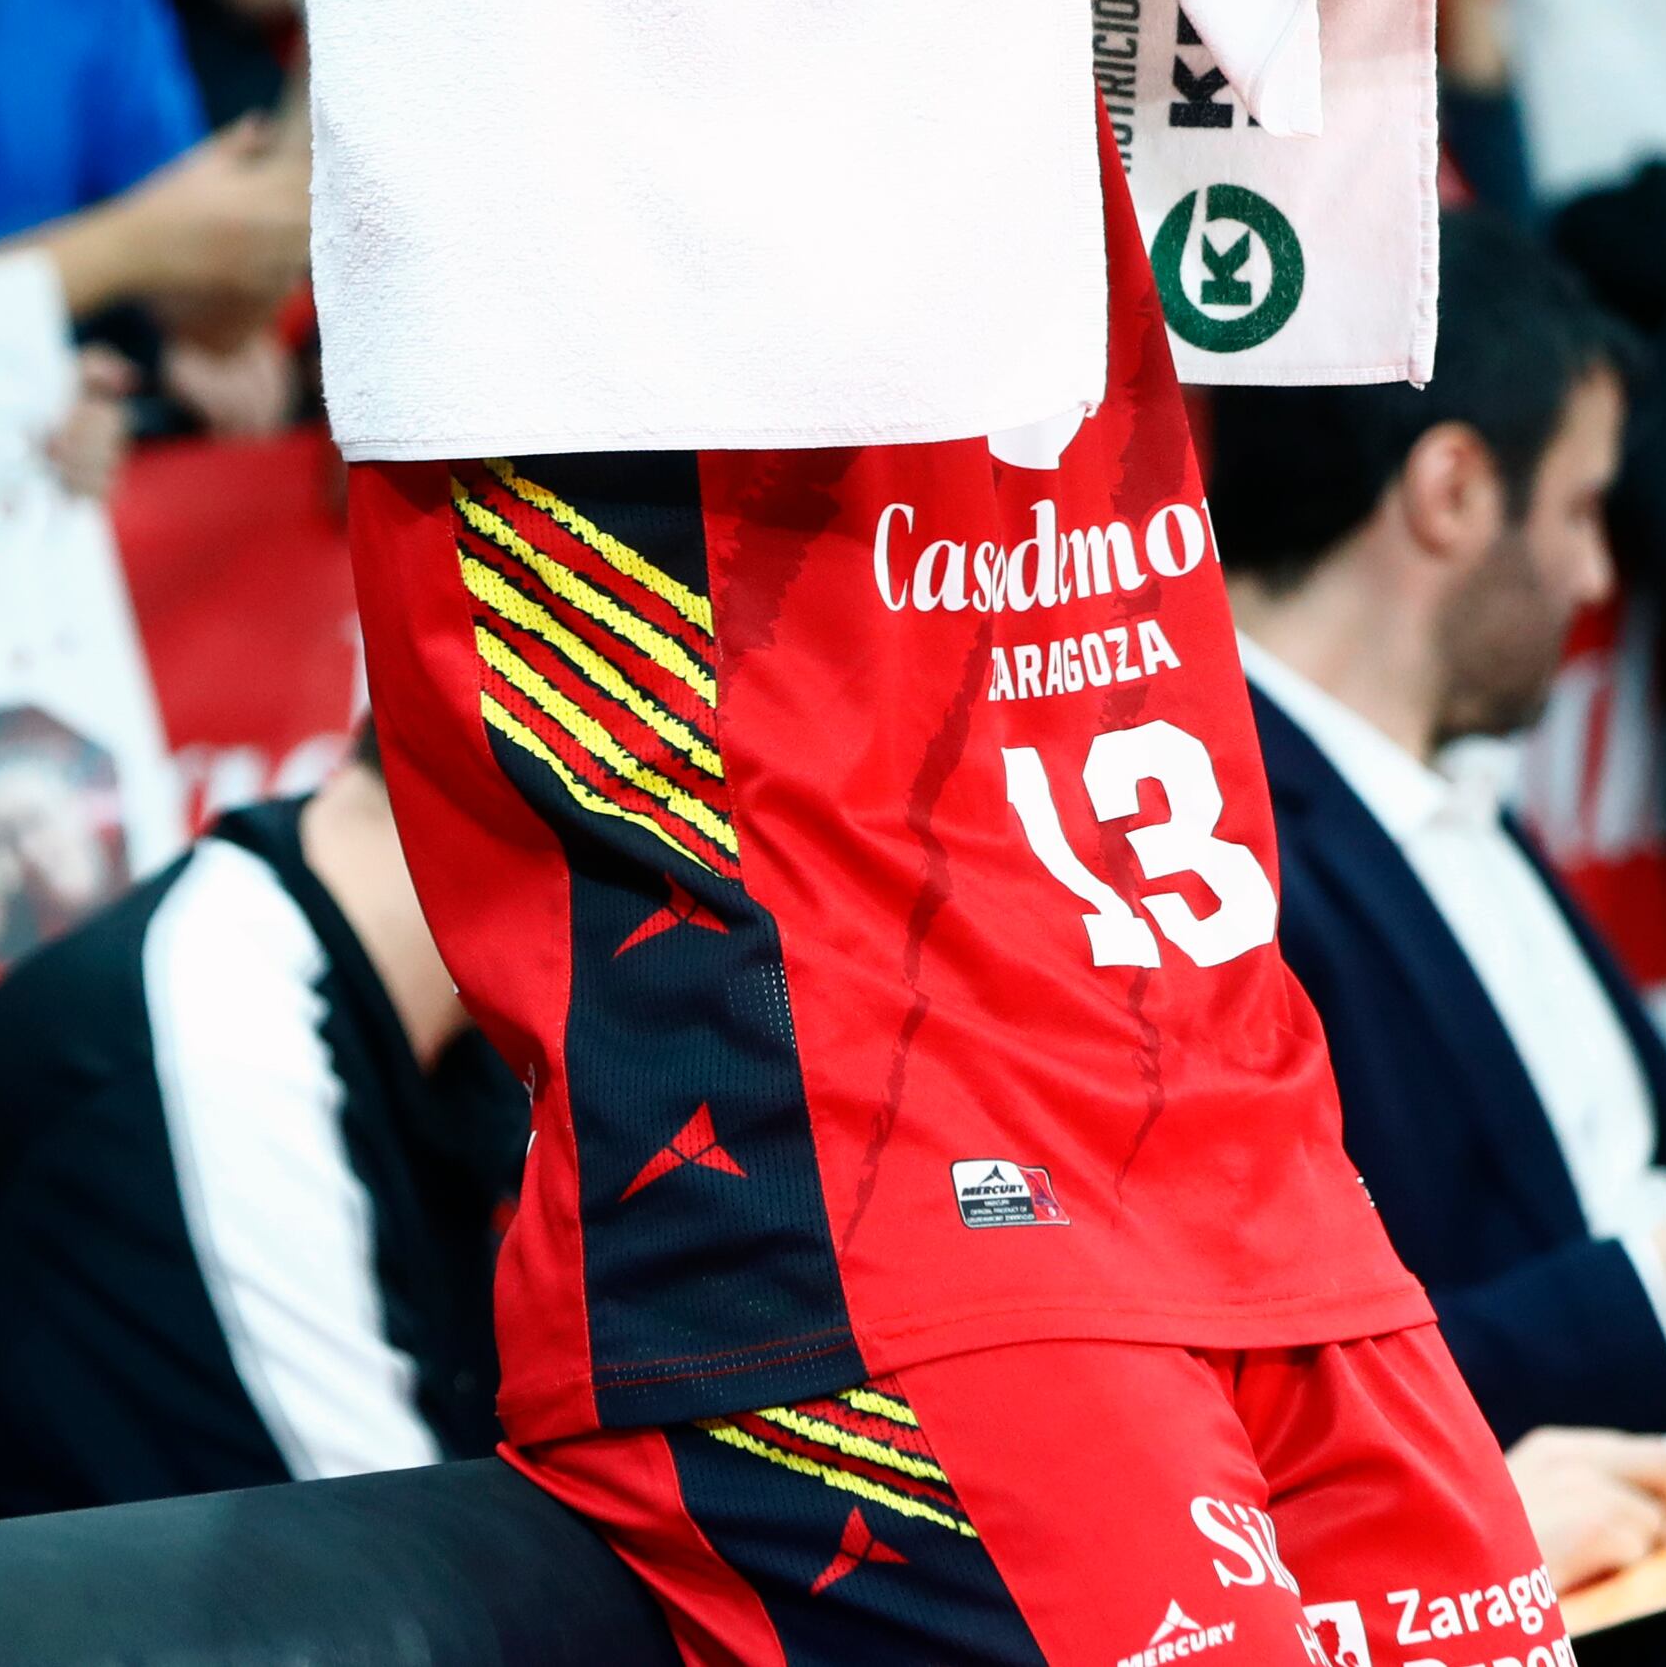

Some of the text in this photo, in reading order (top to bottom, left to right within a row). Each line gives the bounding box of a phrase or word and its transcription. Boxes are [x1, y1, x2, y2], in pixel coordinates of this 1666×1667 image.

[987, 619, 1182, 702] ZARAGOZA
[1000, 718, 1278, 969] 13
[961, 1184, 1024, 1197] MERCURY
